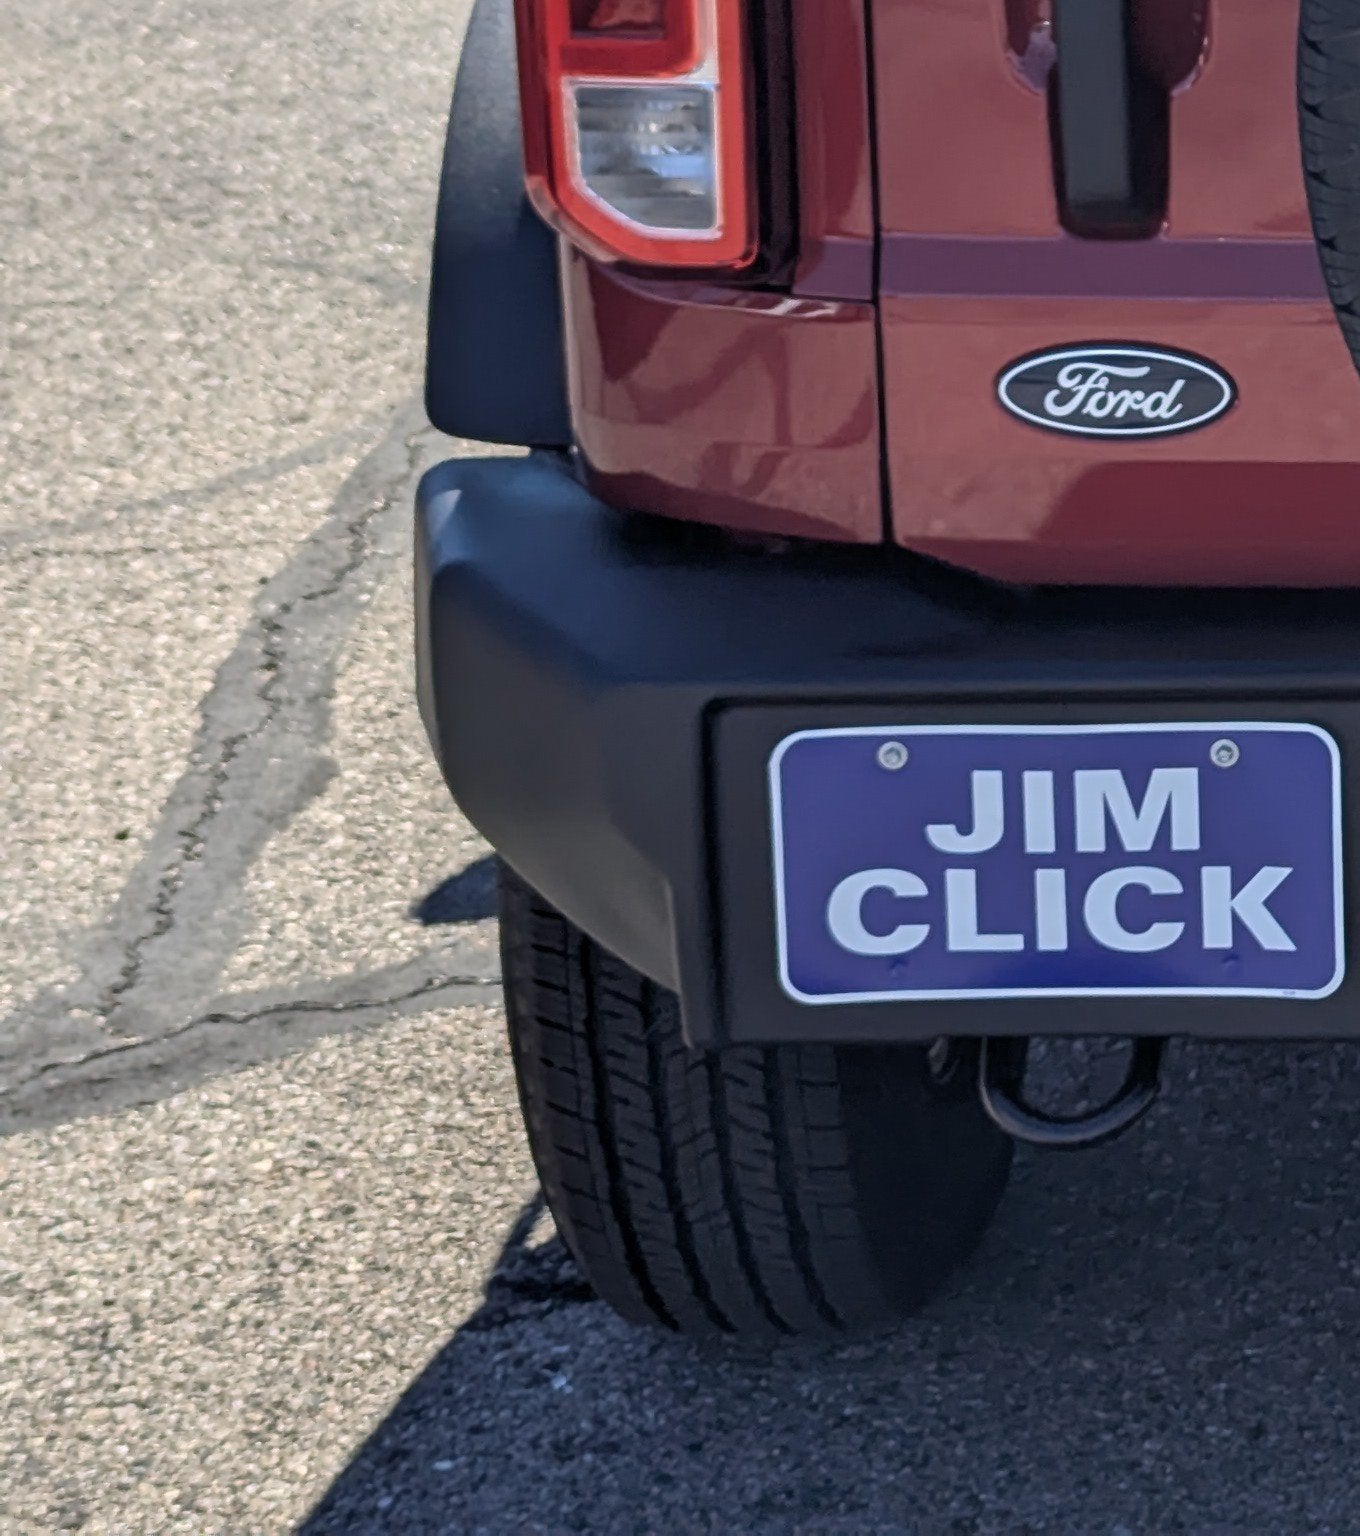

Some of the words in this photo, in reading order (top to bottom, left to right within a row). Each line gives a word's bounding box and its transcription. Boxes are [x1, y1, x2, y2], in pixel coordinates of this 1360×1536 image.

[1043, 361, 1186, 420] Ford
[925, 766, 1201, 855] JIM
[826, 865, 1298, 956] CLICK
